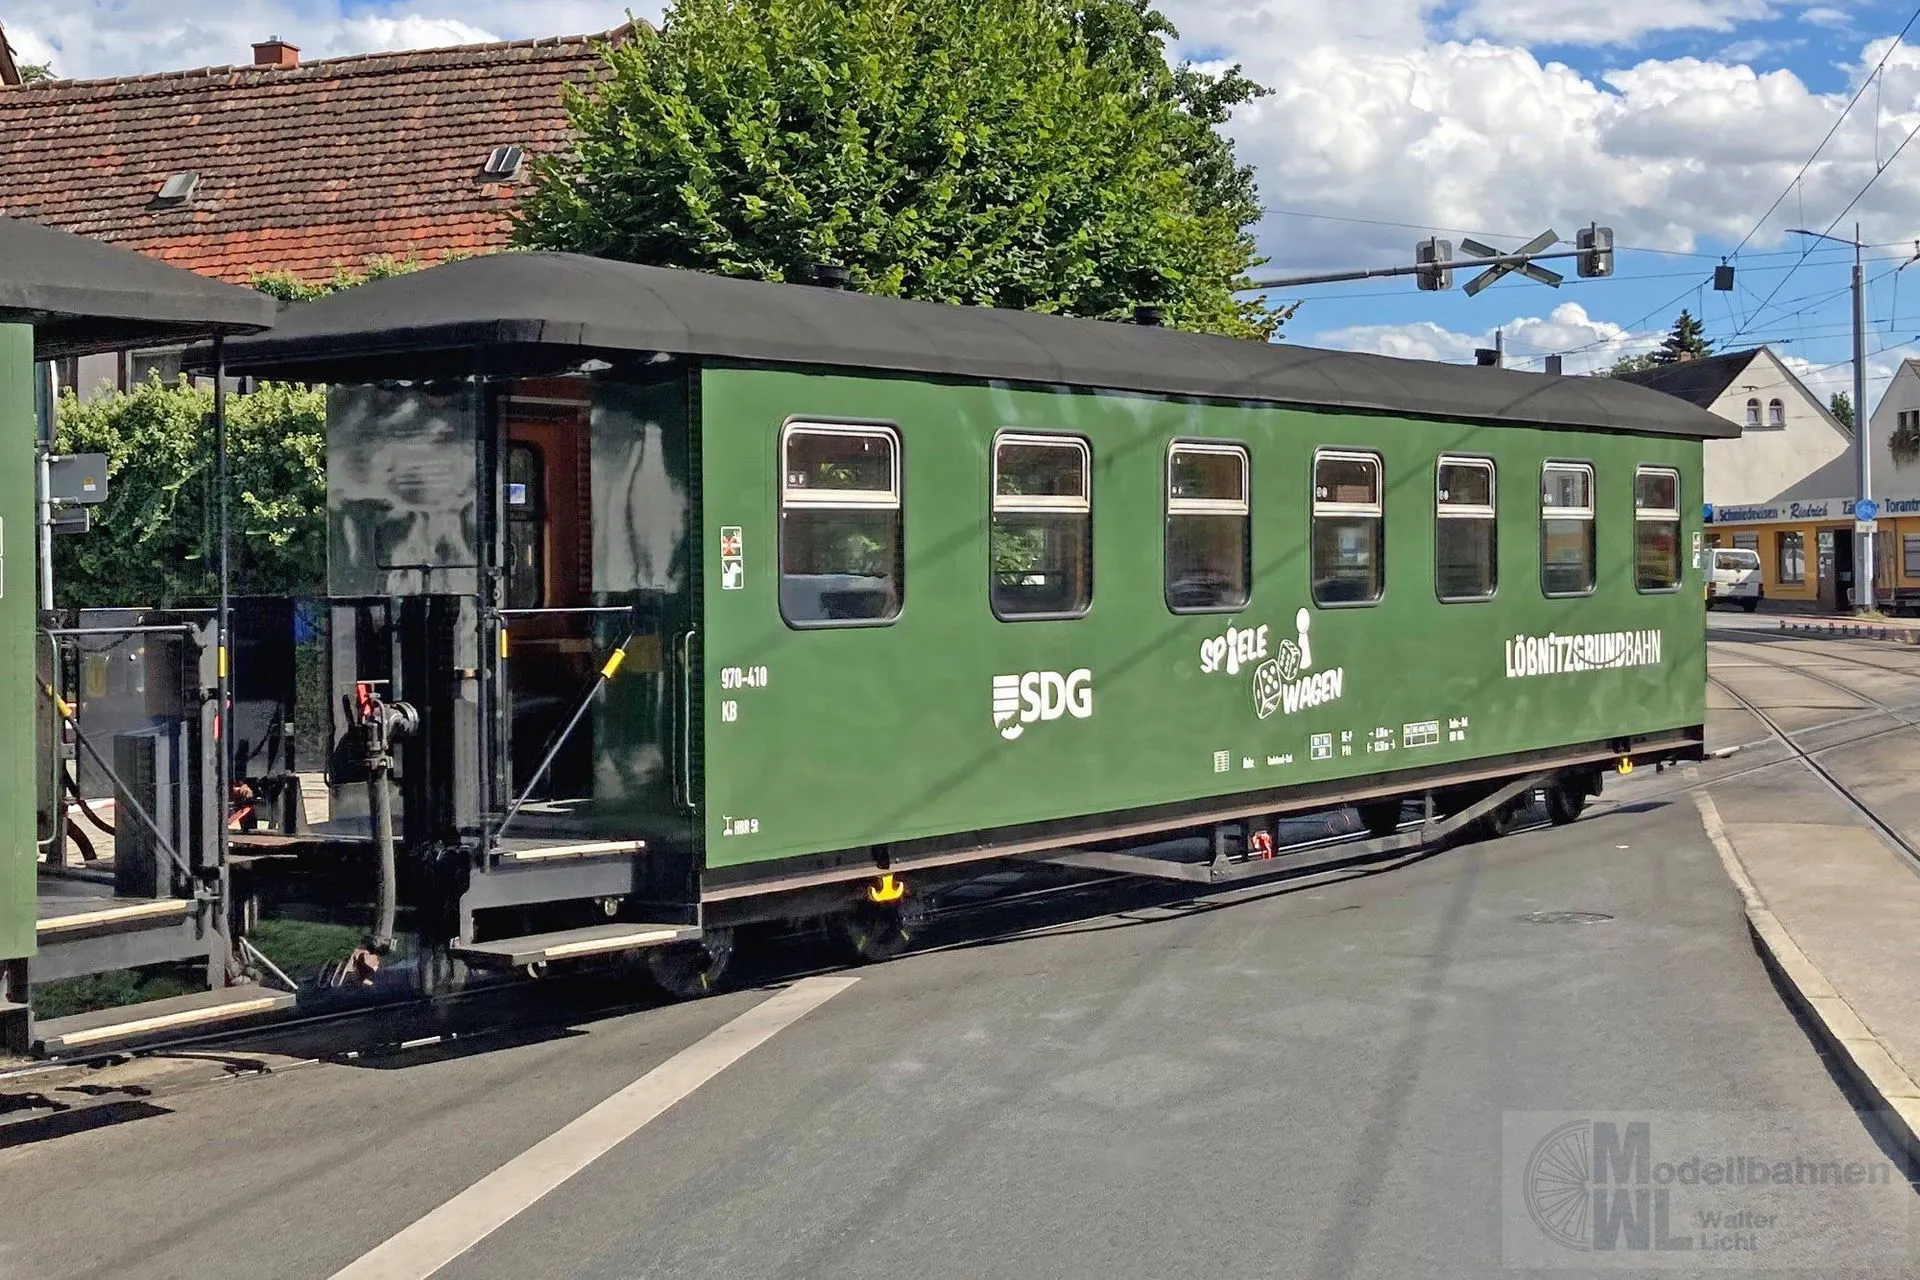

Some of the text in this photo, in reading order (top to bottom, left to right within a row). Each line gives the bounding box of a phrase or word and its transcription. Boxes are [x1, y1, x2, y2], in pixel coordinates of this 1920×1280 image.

[1200, 624, 1268, 674] SPIELE
[721, 665, 767, 689] 970-410
[1019, 668, 1092, 723] SDG
[1282, 667, 1343, 714] WAGEN
[721, 700, 738, 722] KB
